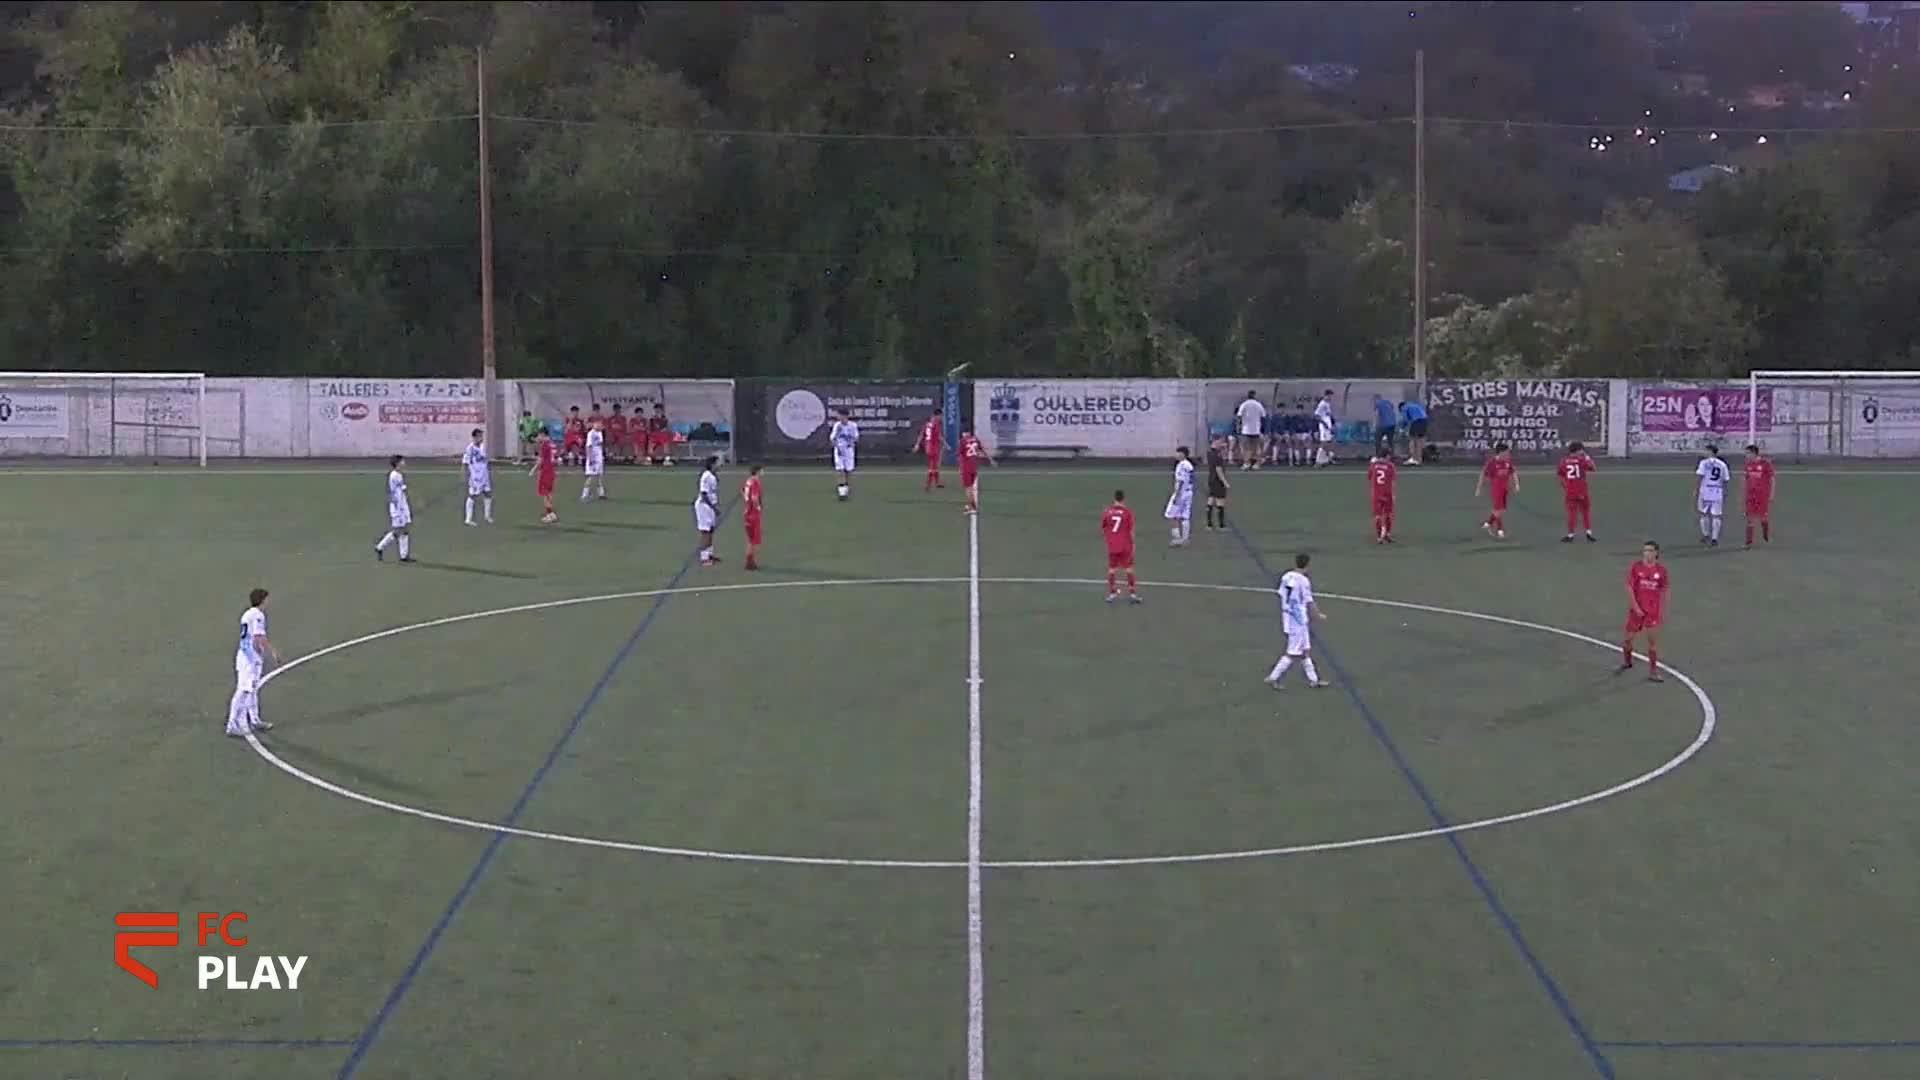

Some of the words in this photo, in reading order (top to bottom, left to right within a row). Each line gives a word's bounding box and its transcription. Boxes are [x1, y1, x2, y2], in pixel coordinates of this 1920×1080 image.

[320, 383, 389, 397] TALLERES
[1459, 382, 1508, 401] TRES
[1516, 380, 1599, 408] MARIAS
[1522, 404, 1560, 417] BAR
[1644, 396, 1682, 413] 25N
[1034, 413, 1124, 425] CONCELLO
[1472, 417, 1484, 427] O
[1489, 417, 1548, 427] BURGO
[1376, 470, 1385, 485] 2
[1566, 464, 1580, 479] 21
[1710, 466, 1721, 481] 9
[1111, 515, 1122, 533] 7
